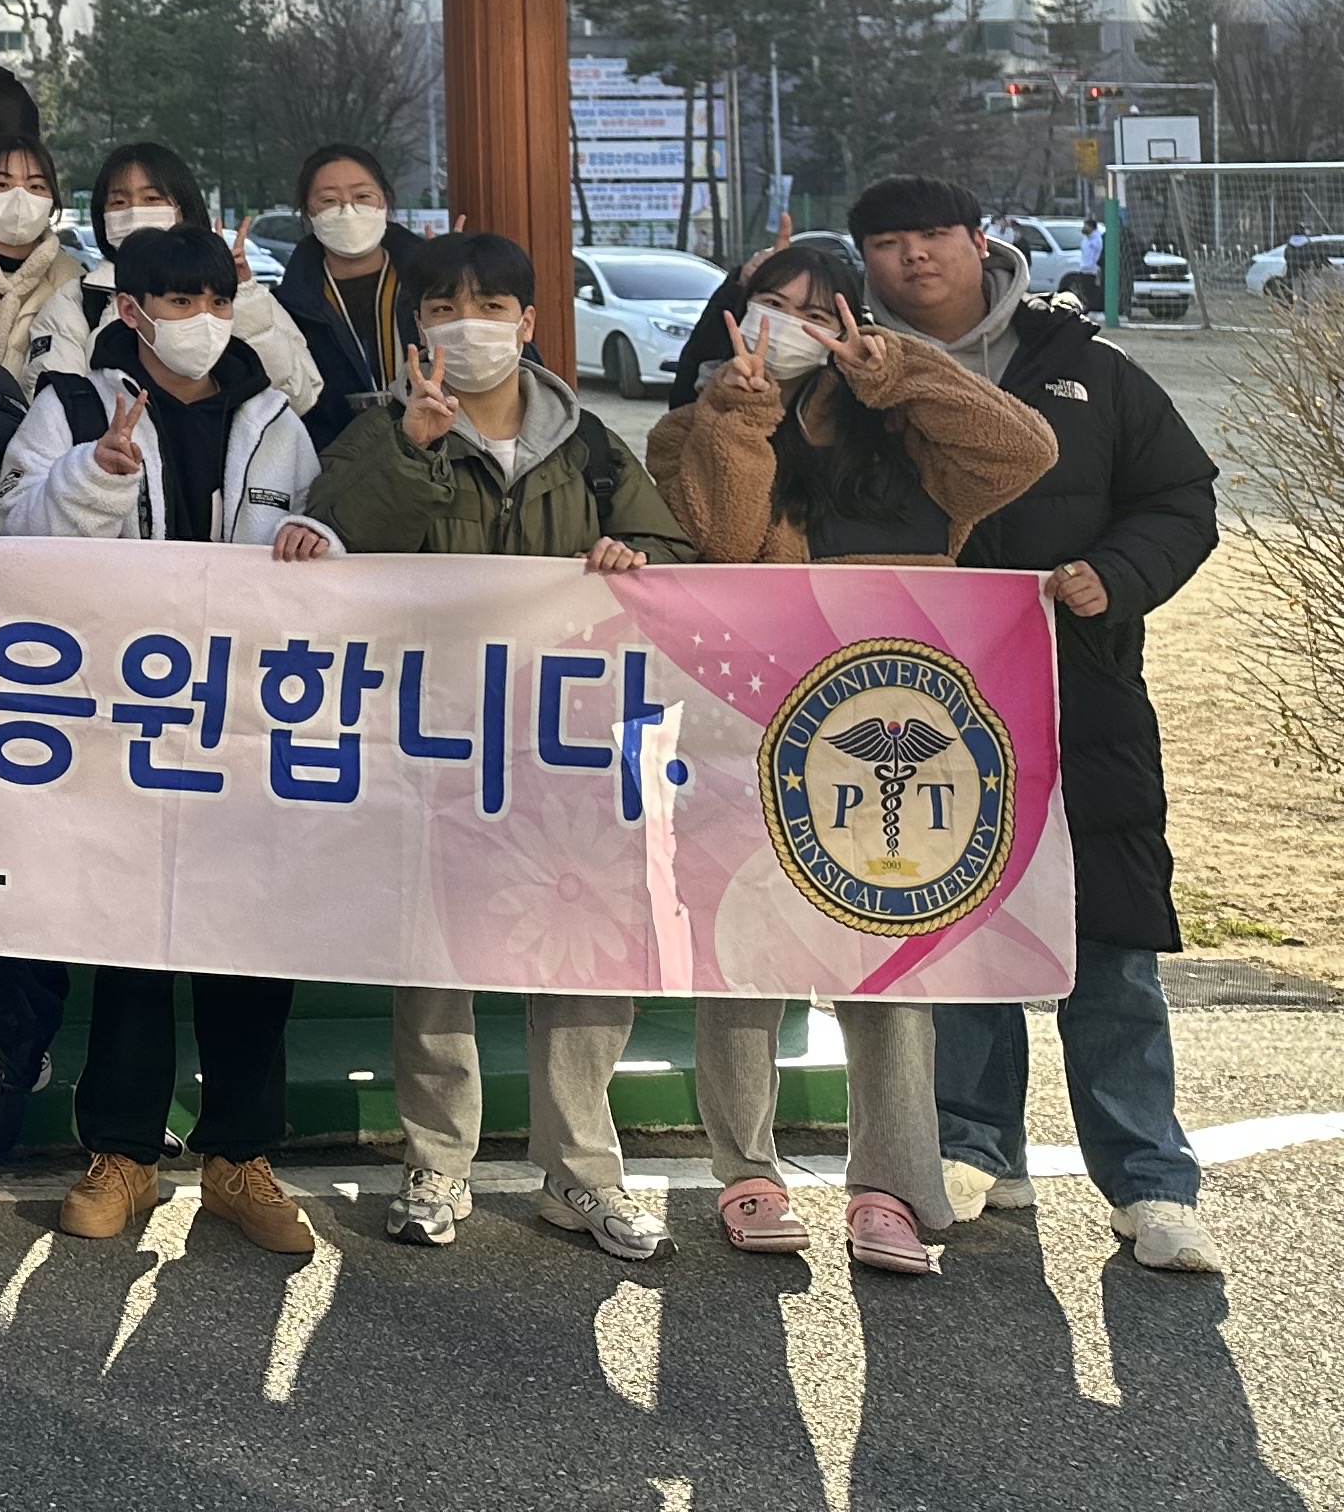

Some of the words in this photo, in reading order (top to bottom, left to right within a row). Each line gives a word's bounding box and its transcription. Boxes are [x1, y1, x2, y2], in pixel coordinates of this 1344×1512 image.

[818, 660, 983, 734] UNIVERSITY
[829, 784, 864, 829] P
[916, 783, 956, 830] T
[788, 813, 892, 915] PHYSICAL
[904, 814, 997, 914] THERAPY
[575, 1190, 600, 1214] N
